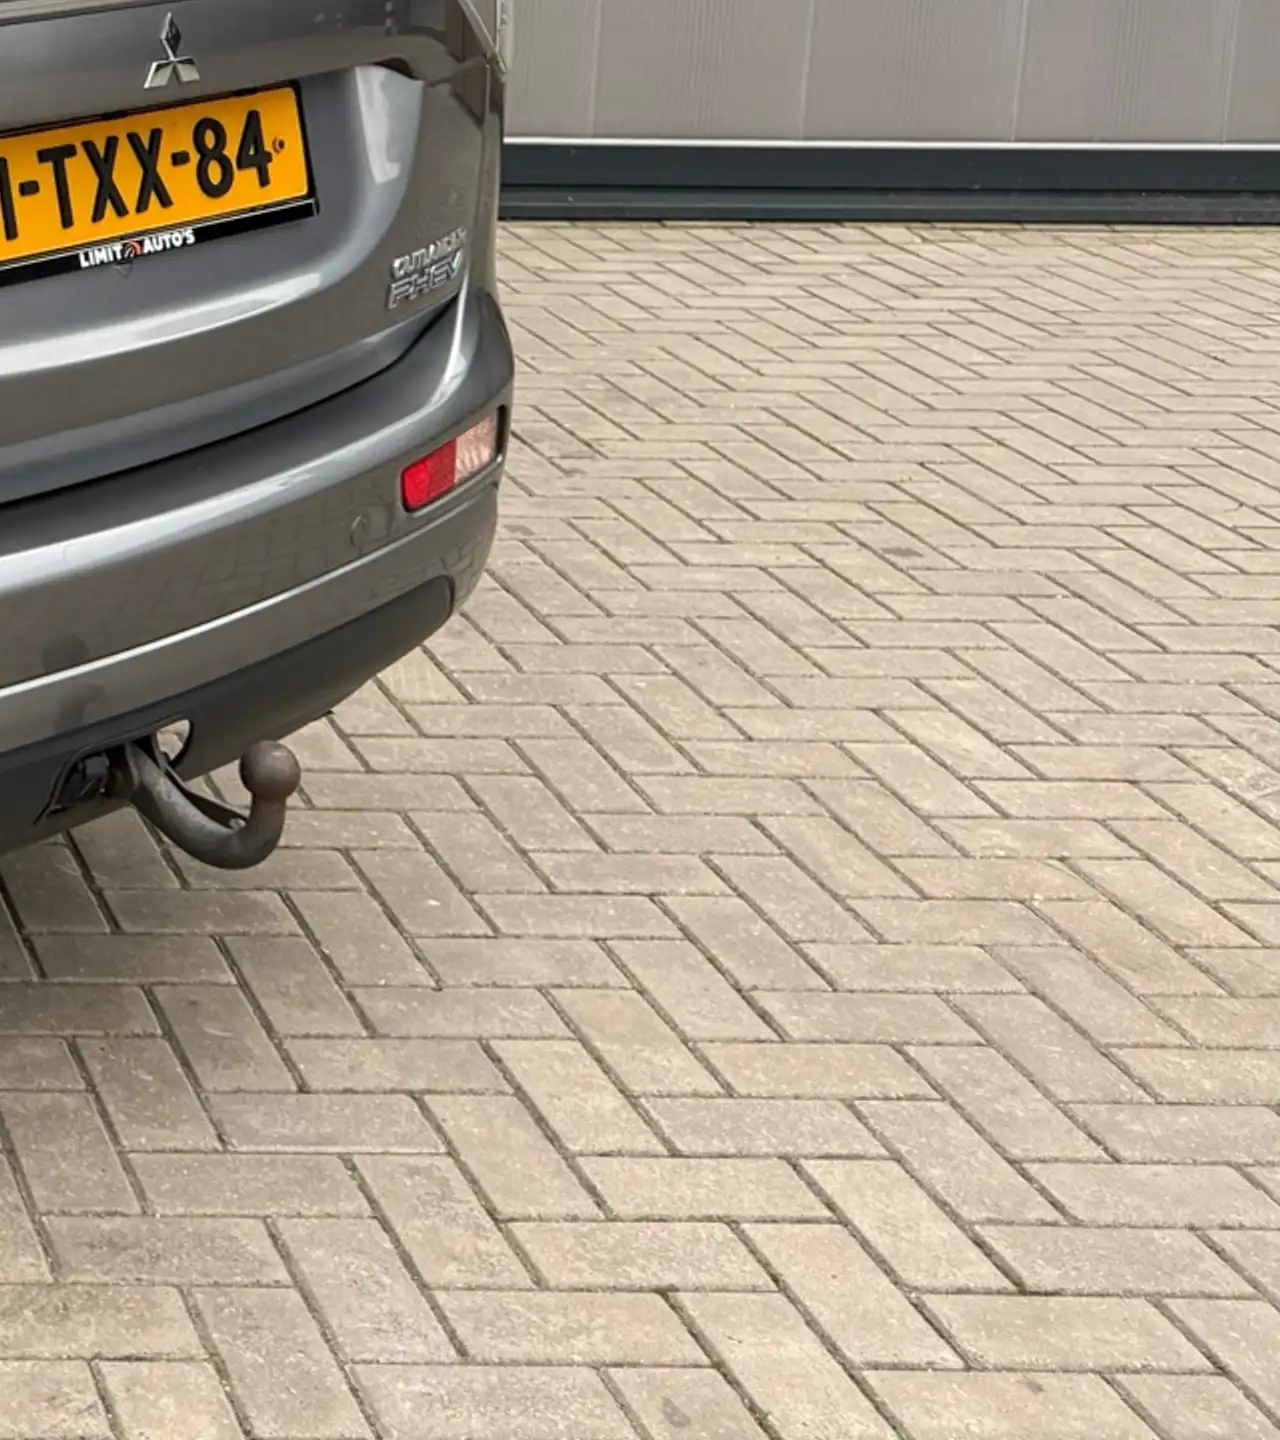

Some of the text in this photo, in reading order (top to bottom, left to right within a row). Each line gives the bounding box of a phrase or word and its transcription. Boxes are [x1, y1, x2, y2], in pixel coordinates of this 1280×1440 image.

[78, 229, 196, 269] LIMIT AUTO'S
[387, 249, 464, 310] PHEV
